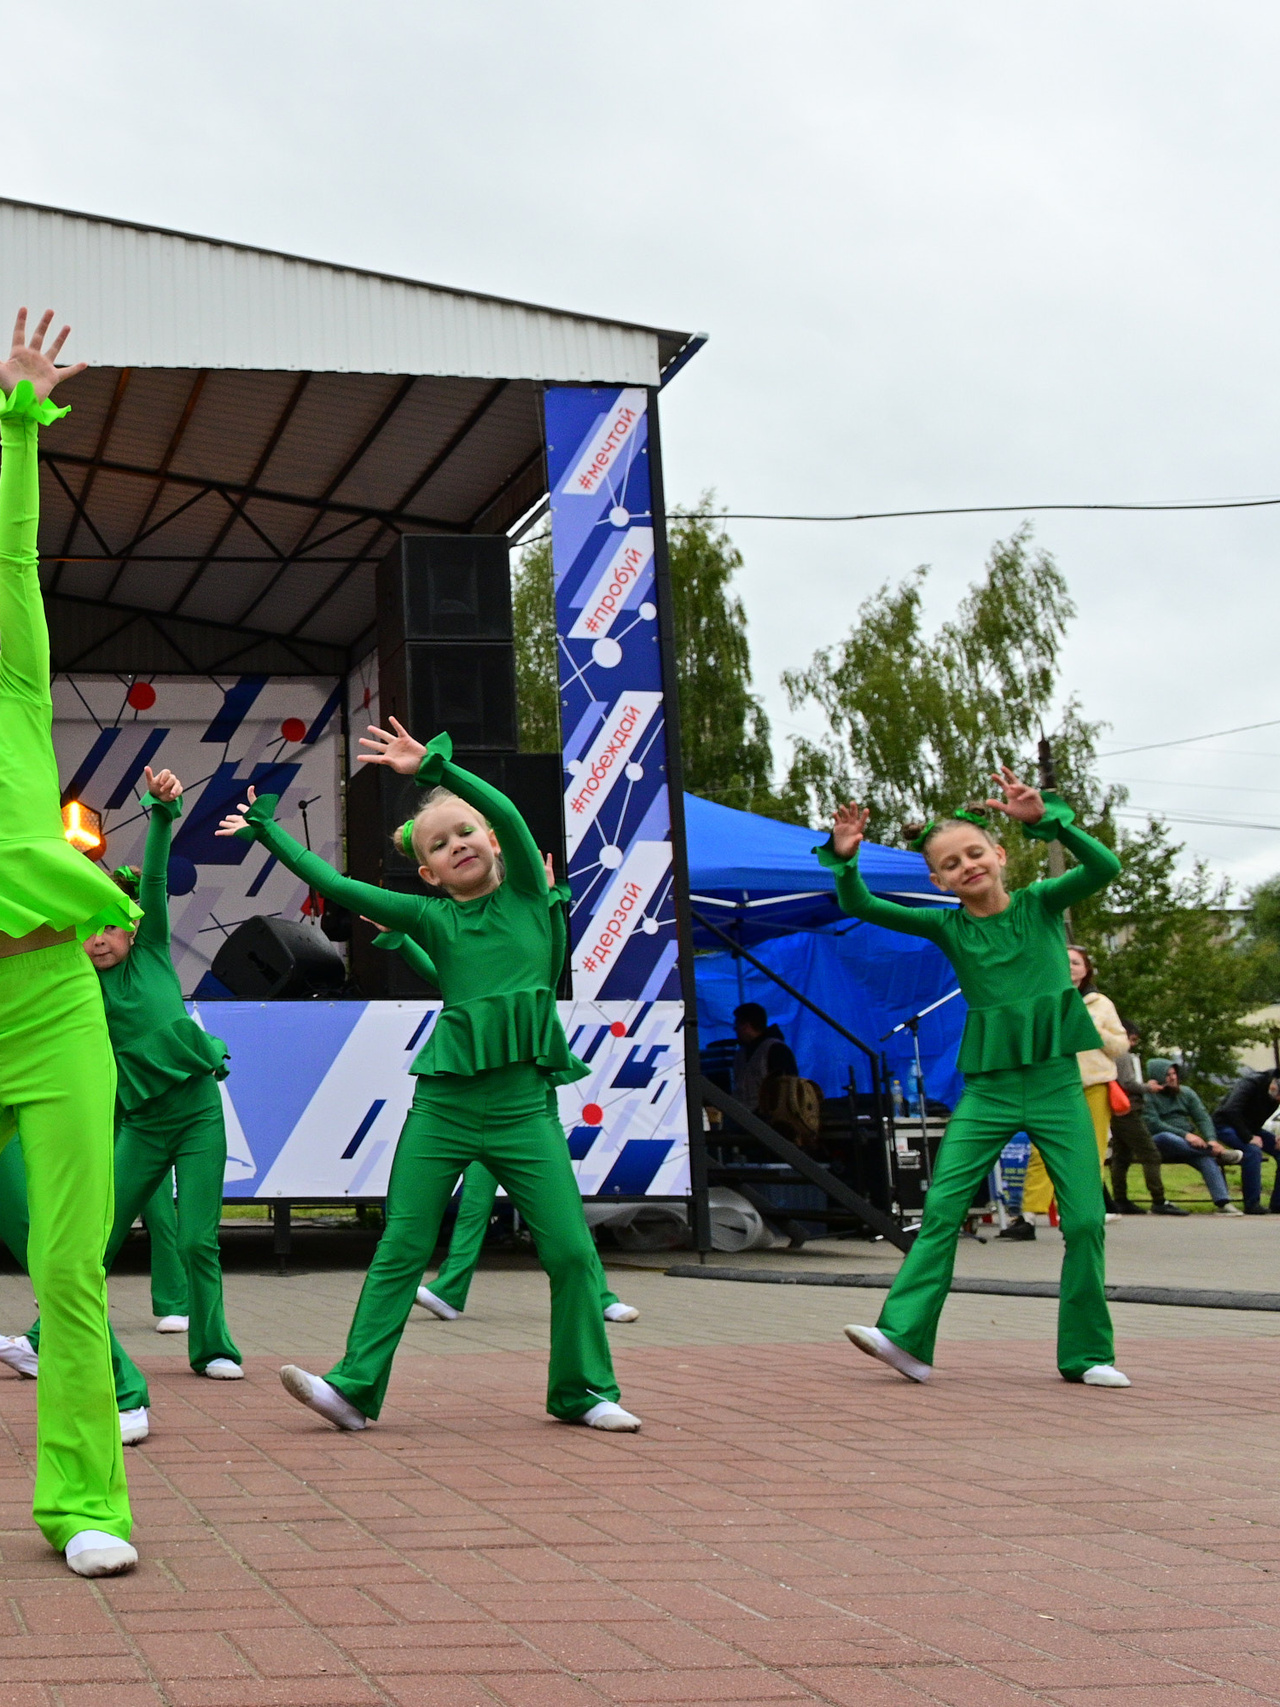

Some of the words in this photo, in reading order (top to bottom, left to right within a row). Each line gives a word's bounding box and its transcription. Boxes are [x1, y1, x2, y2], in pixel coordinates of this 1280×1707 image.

[578, 407, 637, 491] #мечтай
[585, 547, 644, 634] #пробуй
[570, 705, 642, 814] #побеждай
[582, 880, 643, 974] #дерзай
